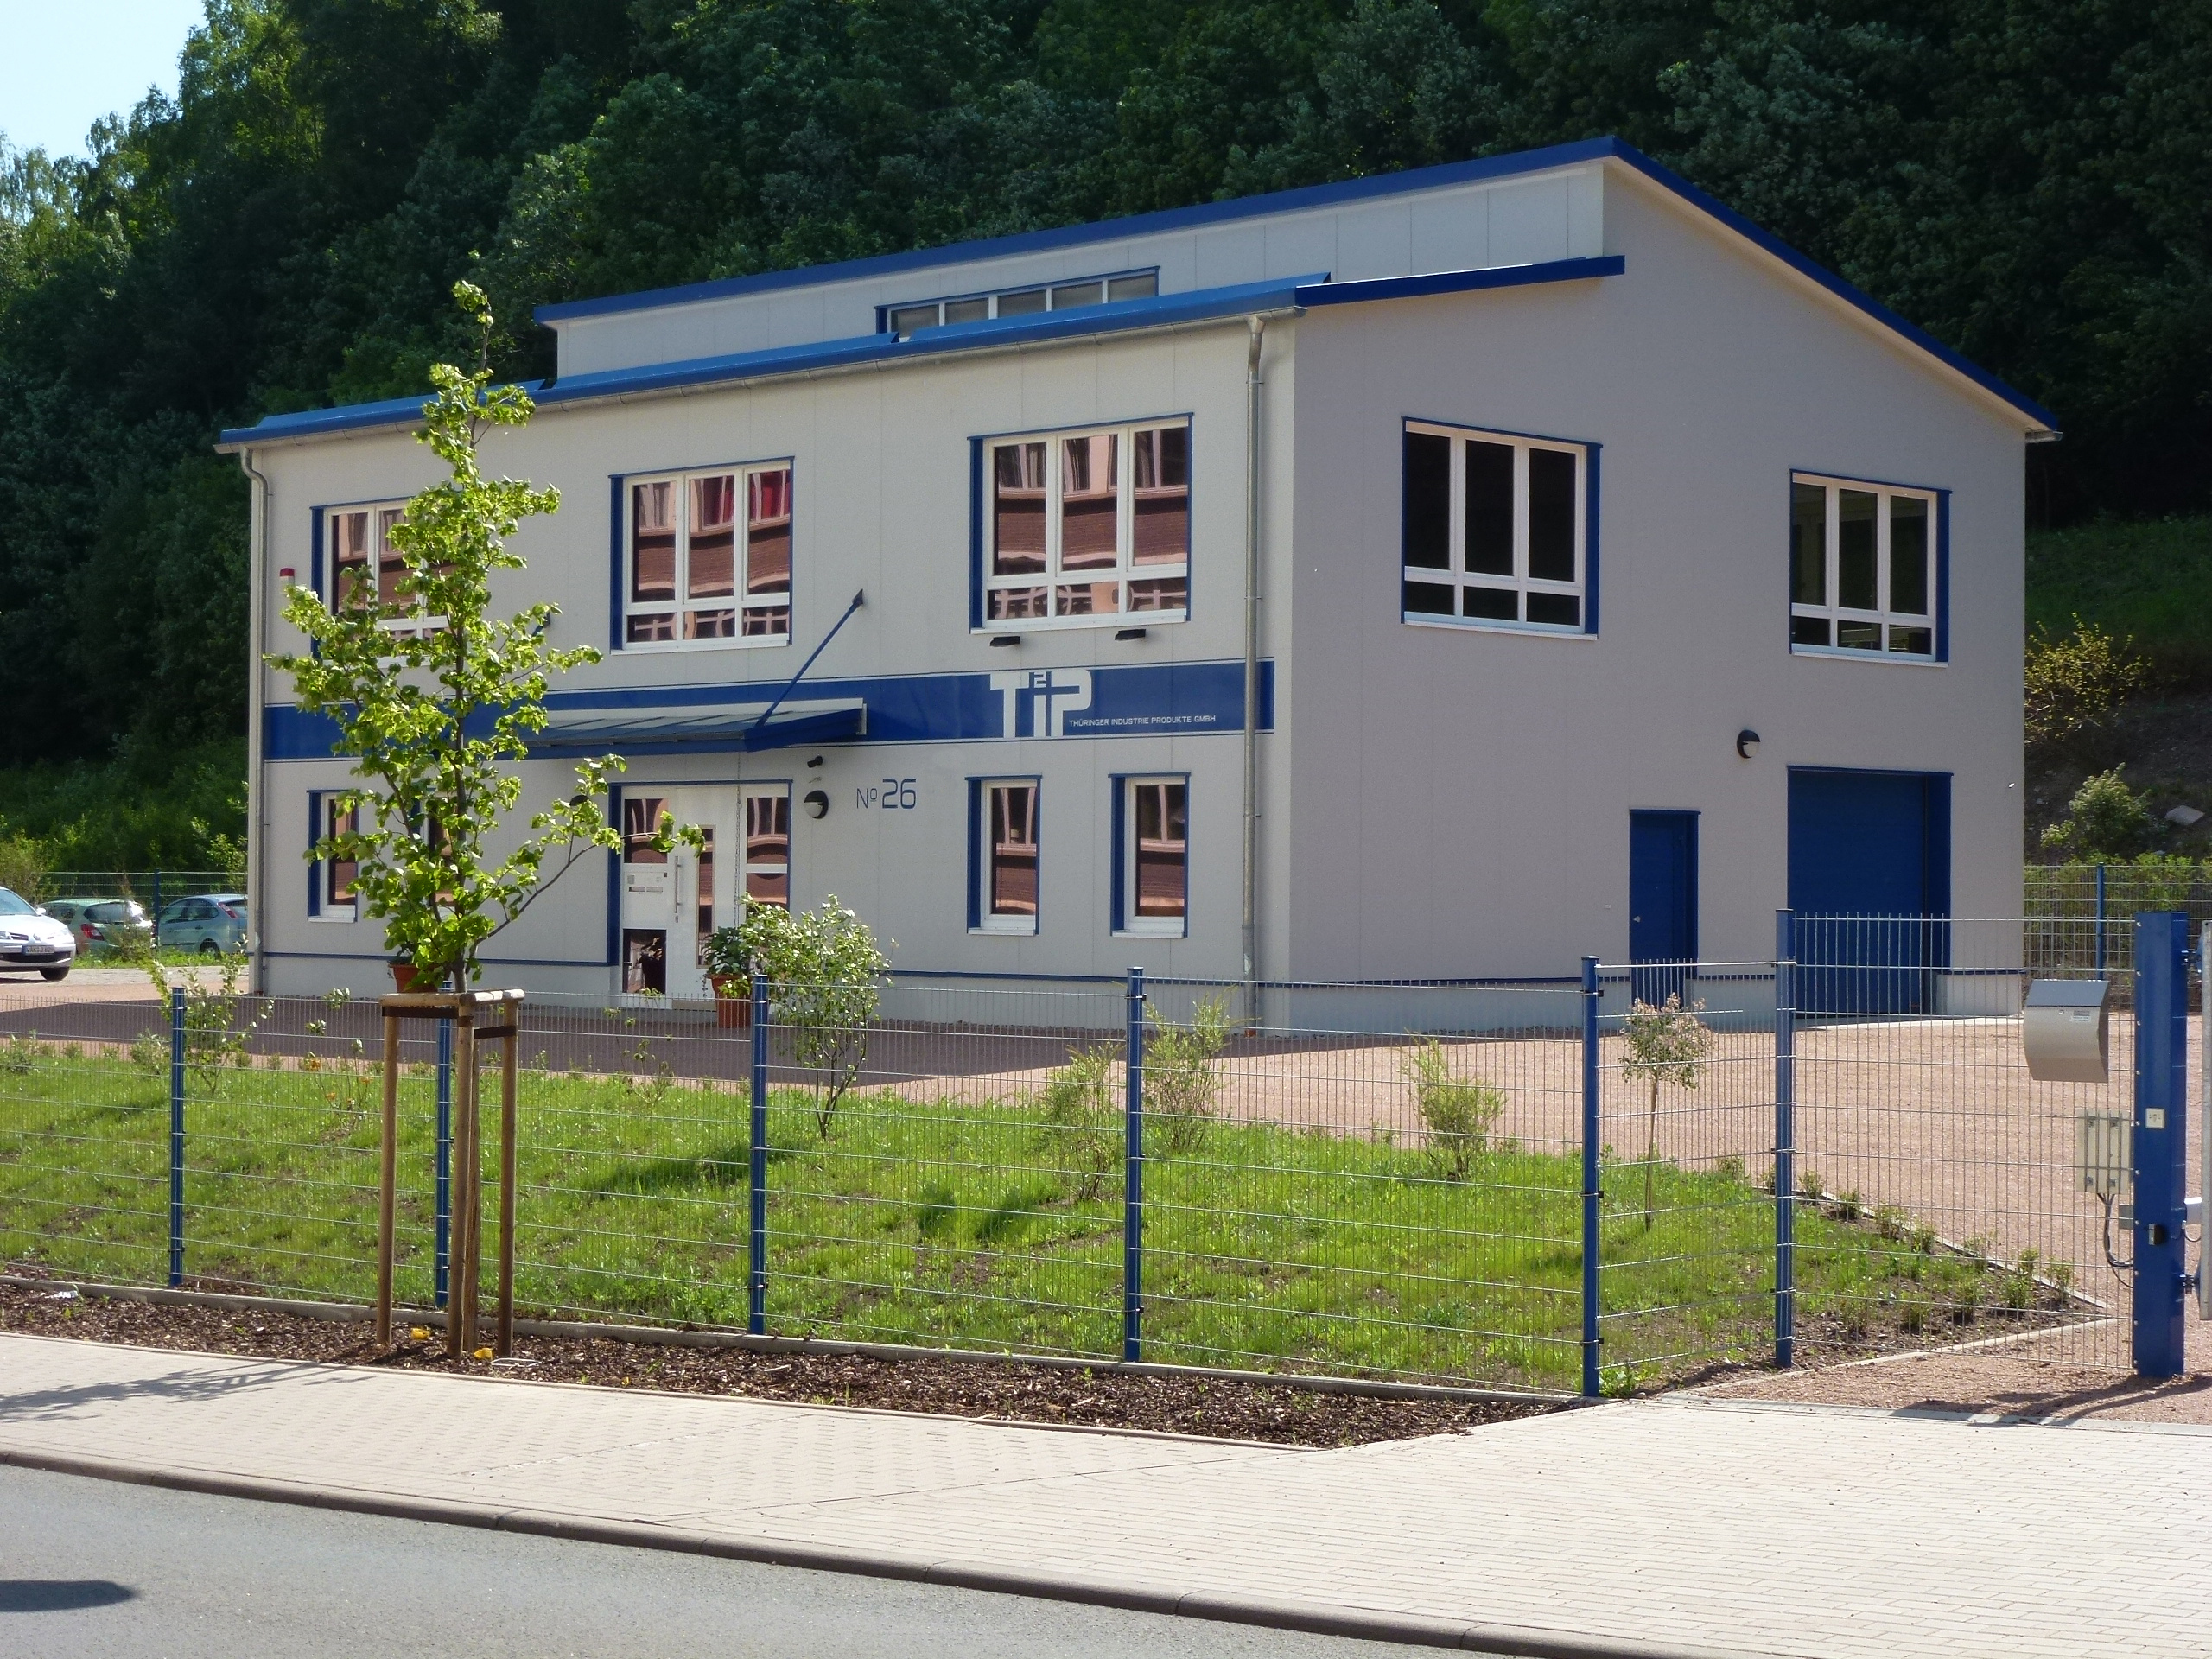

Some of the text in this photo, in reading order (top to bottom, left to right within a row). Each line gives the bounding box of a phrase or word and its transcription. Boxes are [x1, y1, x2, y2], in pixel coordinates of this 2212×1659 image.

[1069, 715, 1216, 728] THÜRINGER INDUSTRIE PRODUKTE GMBH
[881, 779, 917, 809] 26
